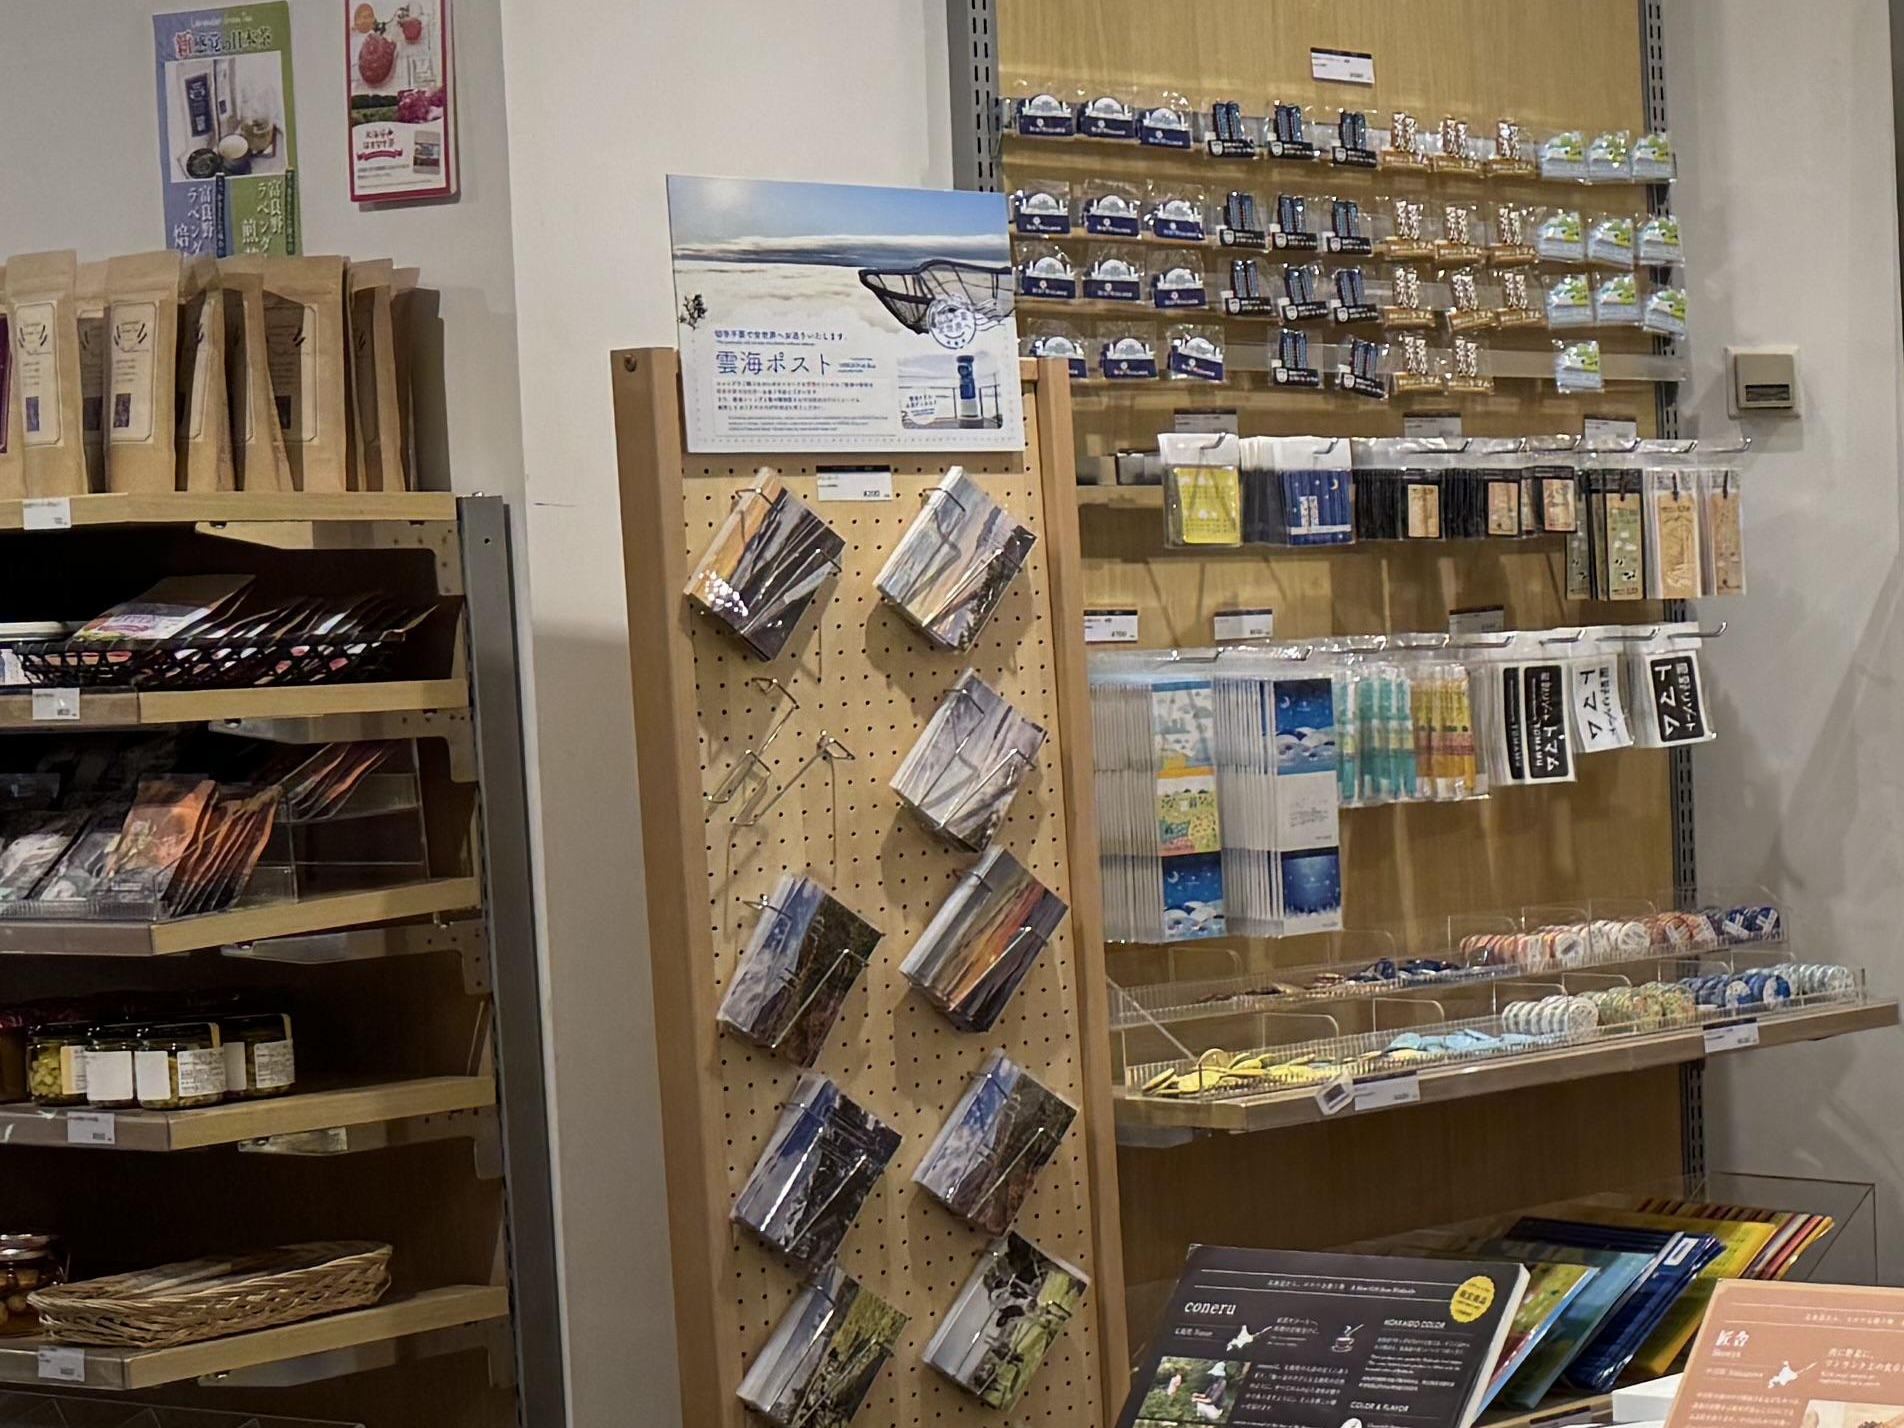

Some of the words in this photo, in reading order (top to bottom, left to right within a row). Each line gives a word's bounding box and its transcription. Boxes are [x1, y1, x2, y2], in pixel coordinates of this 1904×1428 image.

[199, 185, 215, 240] 富良野
[268, 179, 284, 235] 富良野
[716, 351, 831, 376] 雲海ポスト
[1580, 670, 1603, 740] トマム
[1654, 665, 1680, 736] トマム
[1543, 726, 1560, 771] トマム
[1184, 1301, 1237, 1315] coneru
